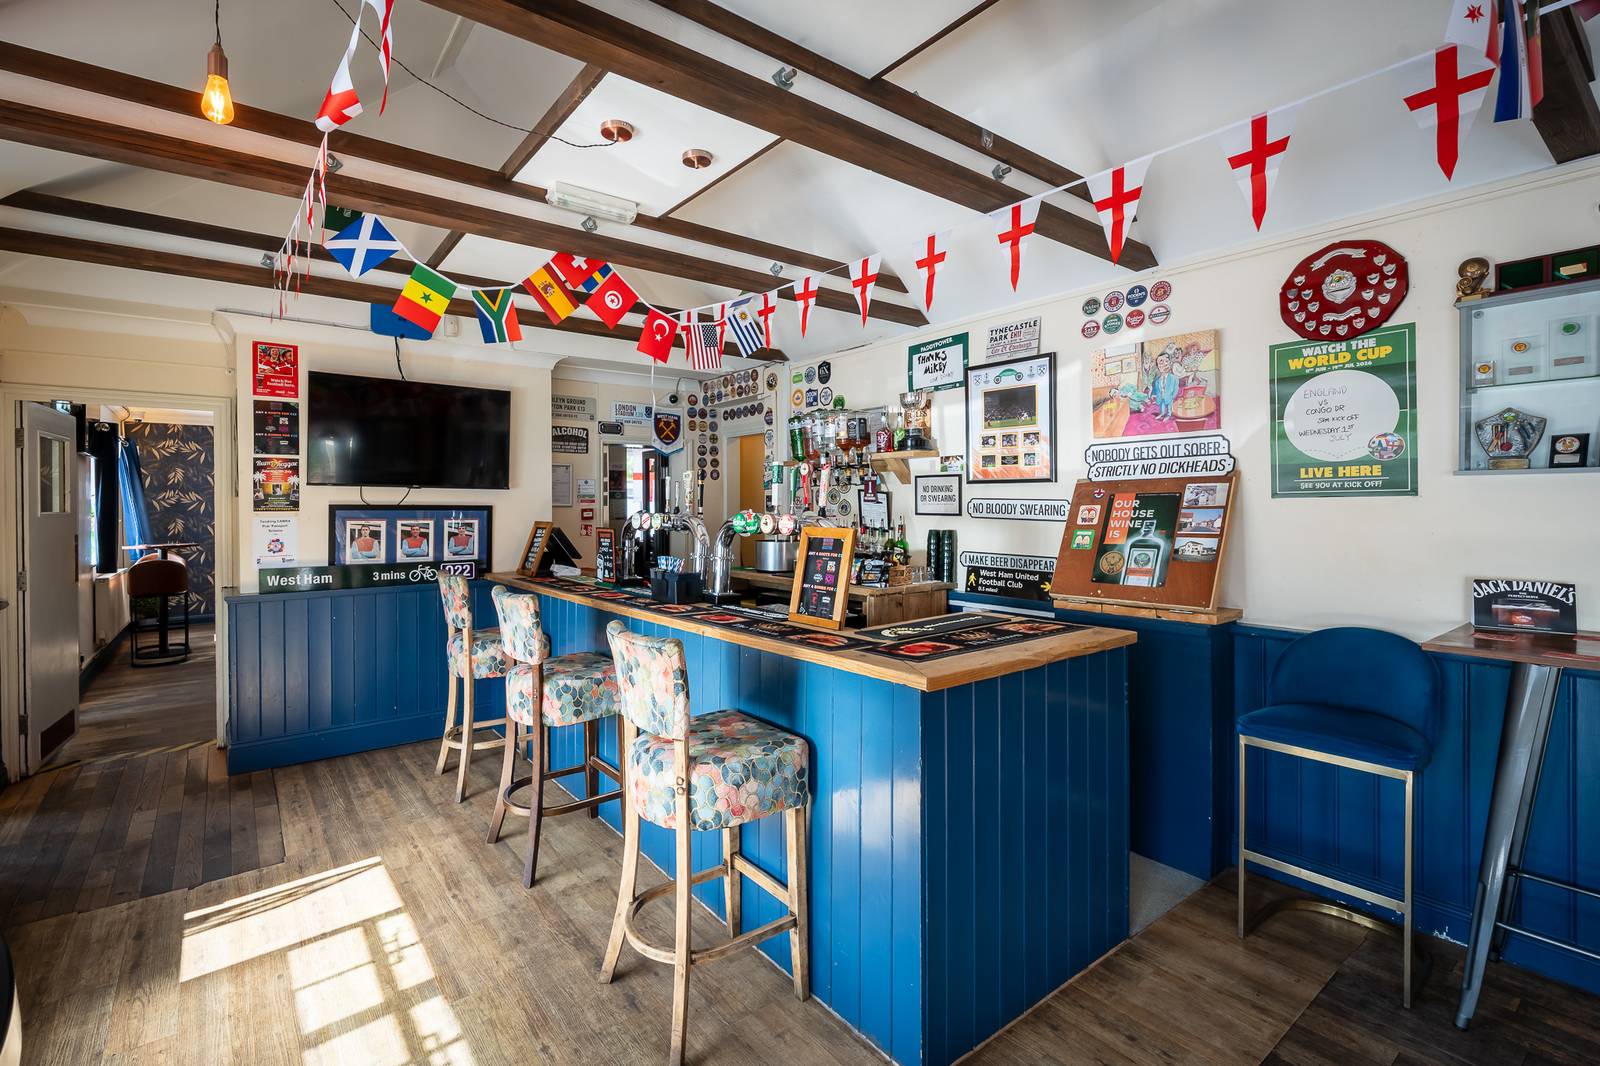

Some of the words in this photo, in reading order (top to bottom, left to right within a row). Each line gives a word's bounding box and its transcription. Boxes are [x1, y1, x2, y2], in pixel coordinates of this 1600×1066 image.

[990, 320, 1038, 336] TYNECASTLE
[989, 333, 1008, 343] PARK
[1302, 342, 1346, 357] WATCH
[1351, 338, 1376, 350] THE
[918, 350, 947, 365] THANKS
[1288, 351, 1351, 370] WORLD
[1356, 345, 1392, 361] CUP
[1303, 384, 1347, 399] ENGLAND
[1318, 398, 1328, 406] VS
[615, 404, 636, 412] LONDON
[1306, 406, 1332, 415] CONGO
[1335, 404, 1345, 412] DR
[1346, 413, 1360, 421] OFF
[552, 427, 587, 438] ALCOHOL
[1298, 426, 1340, 437] WEDNESDAY
[1329, 433, 1352, 442] JULY
[1092, 448, 1130, 462] NOBODY
[1133, 445, 1157, 459] GETS
[1160, 444, 1181, 458] OUT
[1184, 441, 1220, 455] SOBER
[1094, 464, 1140, 478] STRICTLY
[1140, 463, 1156, 475] NO
[1158, 459, 1226, 474] DICKHEADS
[1300, 466, 1333, 478] LIVE
[1337, 464, 1382, 477] HERE
[922, 485, 929, 493] NO
[920, 494, 927, 502] OR
[928, 494, 956, 502] SWEARING
[973, 502, 984, 514] NO
[985, 503, 1018, 515] BLOODY
[1019, 504, 1066, 517] SWEARING
[1114, 500, 1140, 508] OUR
[1112, 510, 1155, 518] HOUSE
[1110, 520, 1143, 528] WINE
[1108, 530, 1120, 538] IS
[969, 555, 988, 565] MAKE
[990, 556, 1008, 567] BEER
[1010, 558, 1054, 571] DISAPPEAR
[266, 576, 300, 586] West
[304, 574, 332, 585] Ham
[372, 572, 379, 581] 3
[381, 571, 406, 580] mins
[979, 569, 997, 577] West
[998, 571, 1014, 579] Ham
[1015, 572, 1039, 581] United
[978, 578, 1005, 587] Football
[1473, 579, 1511, 598] JACK
[1512, 580, 1576, 604] DANIEL'S
